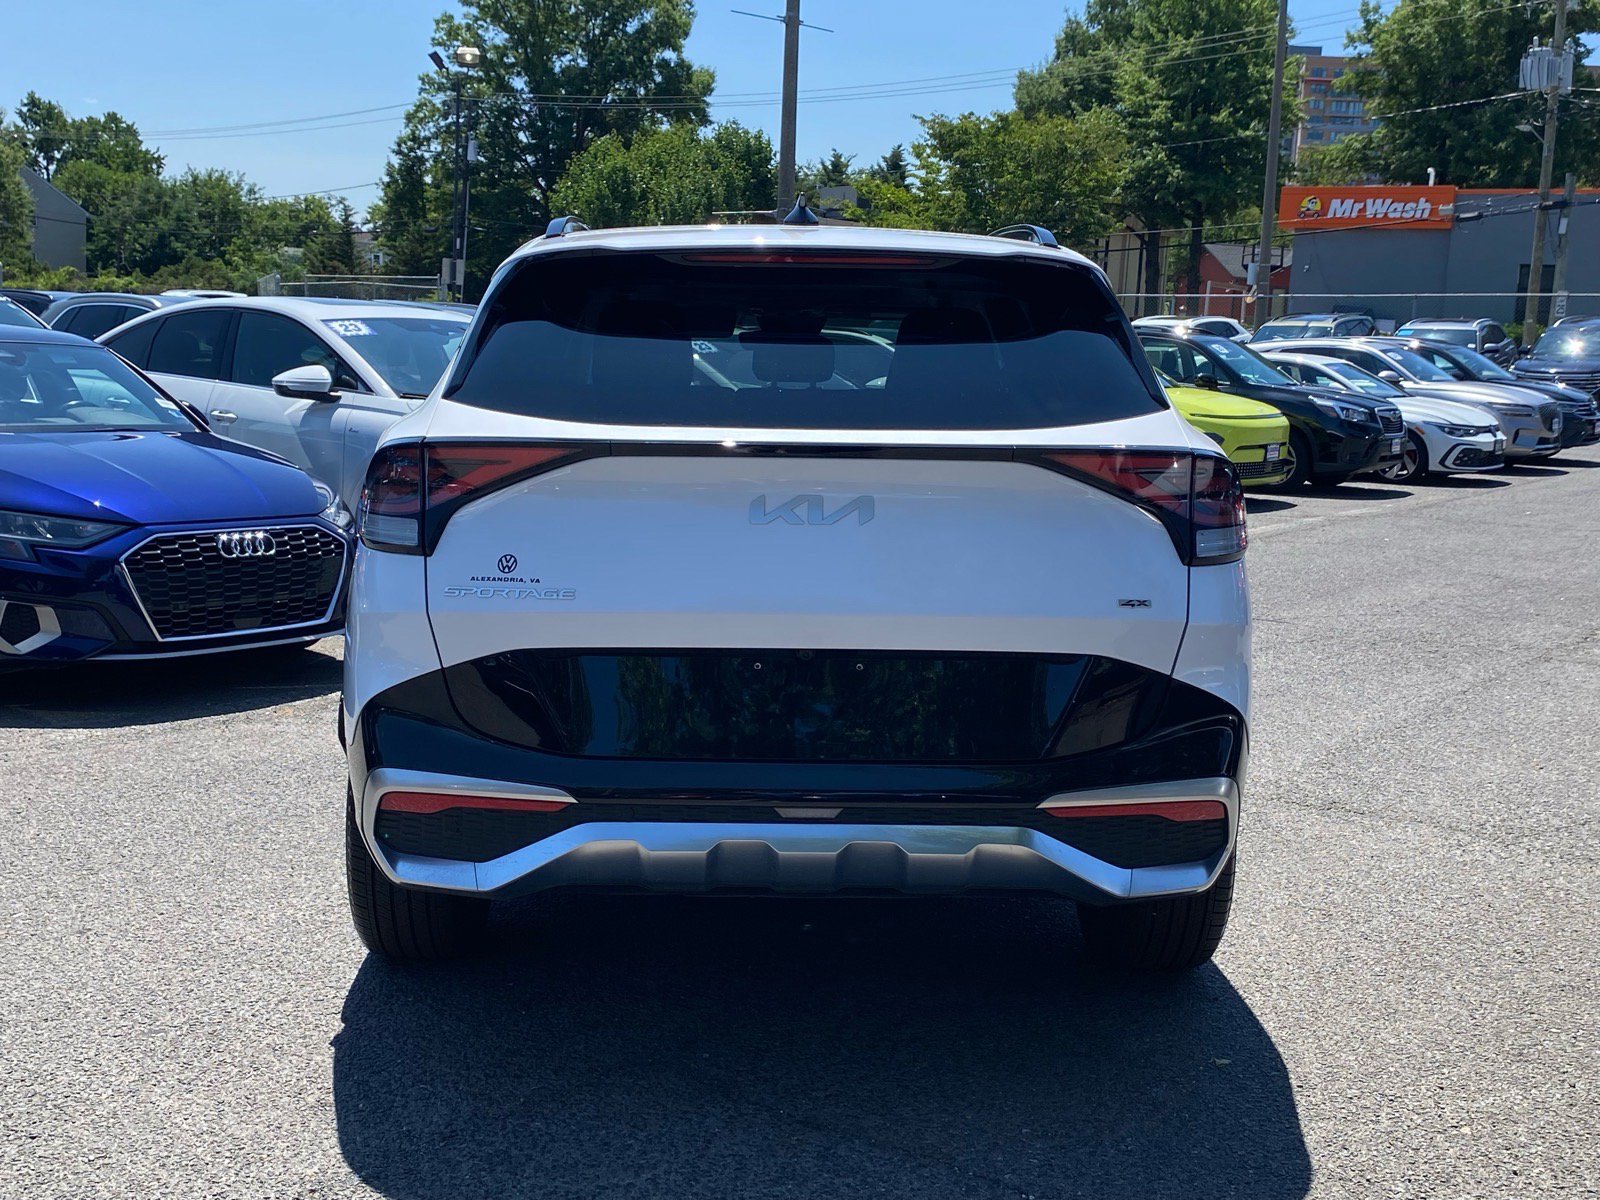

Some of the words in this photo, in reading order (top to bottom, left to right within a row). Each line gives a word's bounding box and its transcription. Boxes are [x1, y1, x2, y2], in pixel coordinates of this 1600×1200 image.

[1327, 198, 1364, 218] Mr
[1365, 197, 1432, 218] Wash
[338, 323, 362, 332] 23
[470, 576, 527, 584] ALEXANDRIA,
[443, 586, 577, 600] SPORTAGE
